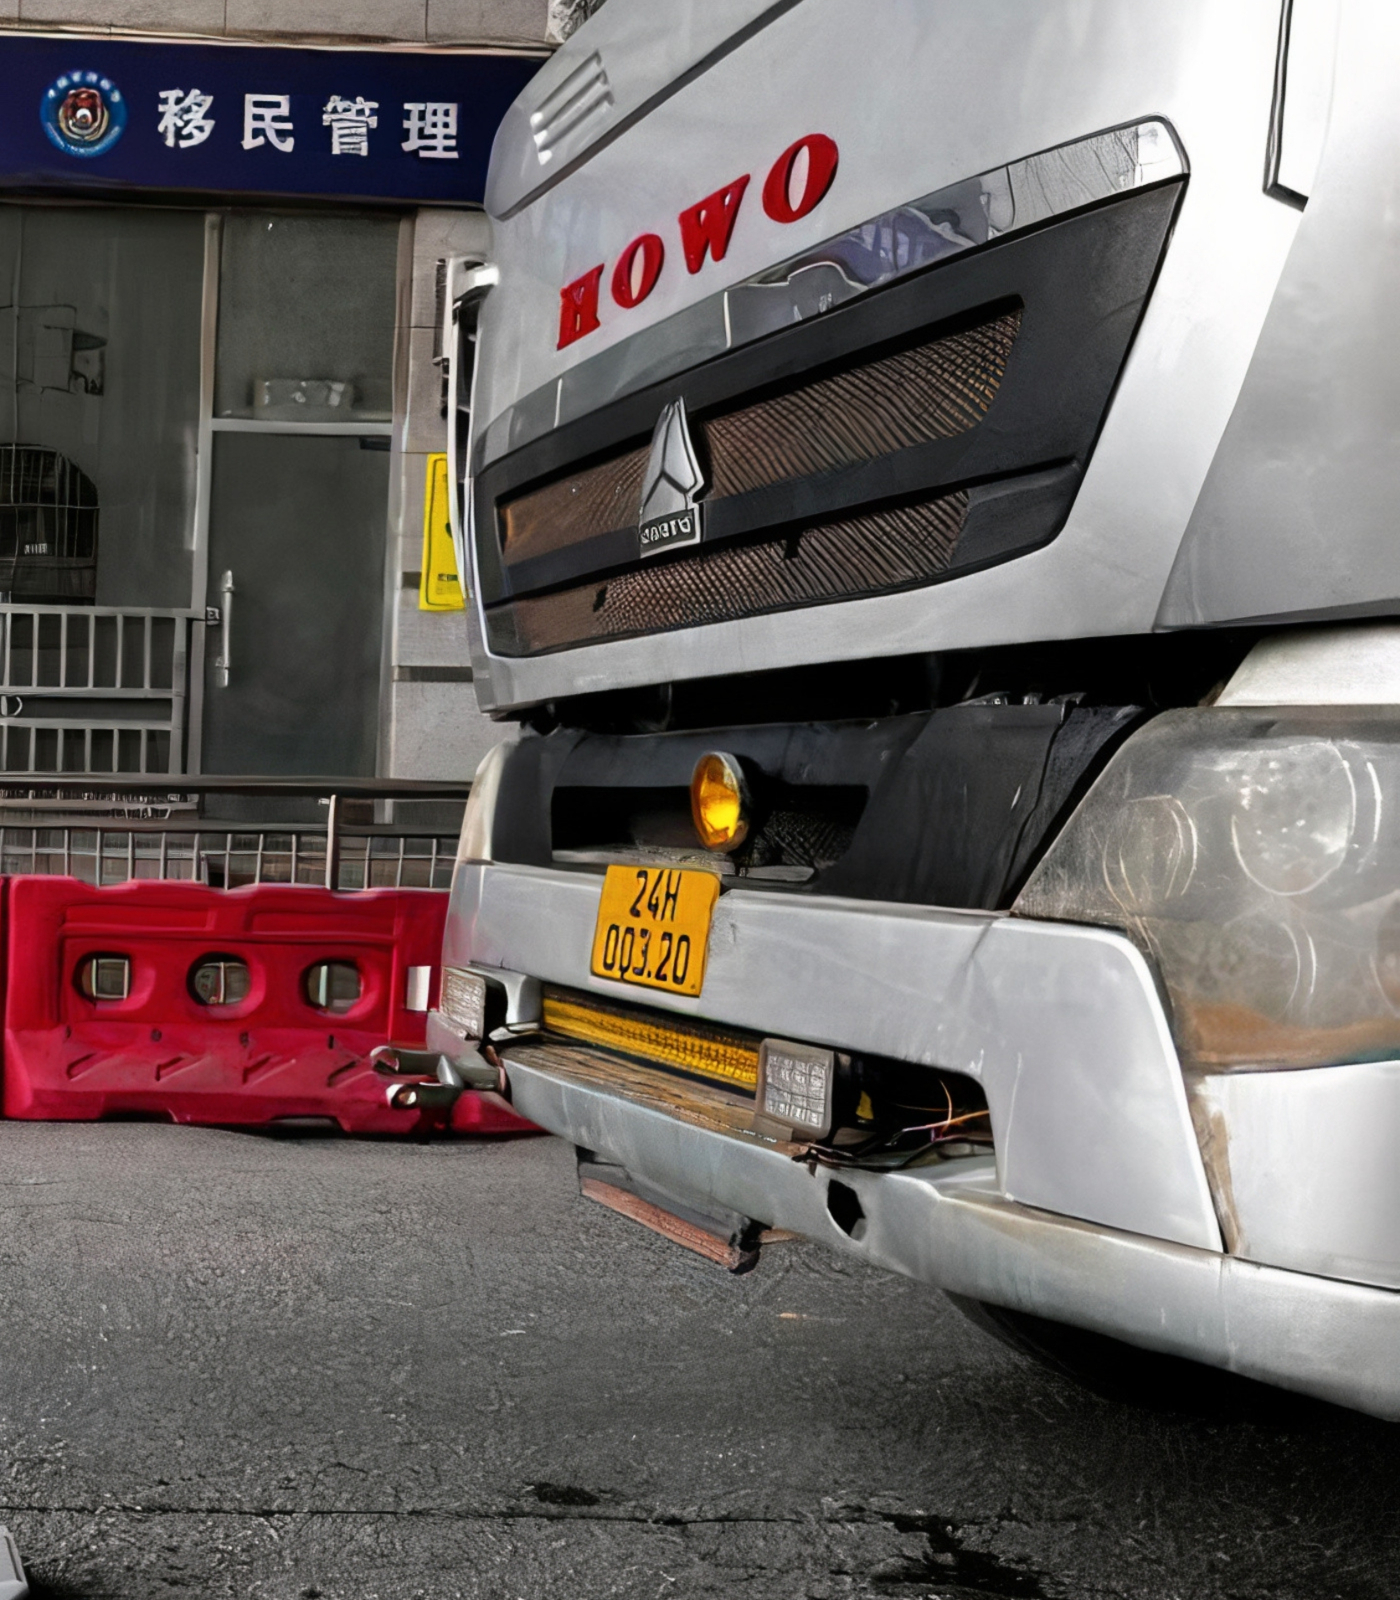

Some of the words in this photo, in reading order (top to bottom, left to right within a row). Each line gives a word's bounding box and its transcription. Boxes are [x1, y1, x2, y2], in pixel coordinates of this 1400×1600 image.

[158, 88, 459, 159] 移民管理
[557, 133, 839, 351] HOWO
[629, 869, 682, 922] 24H
